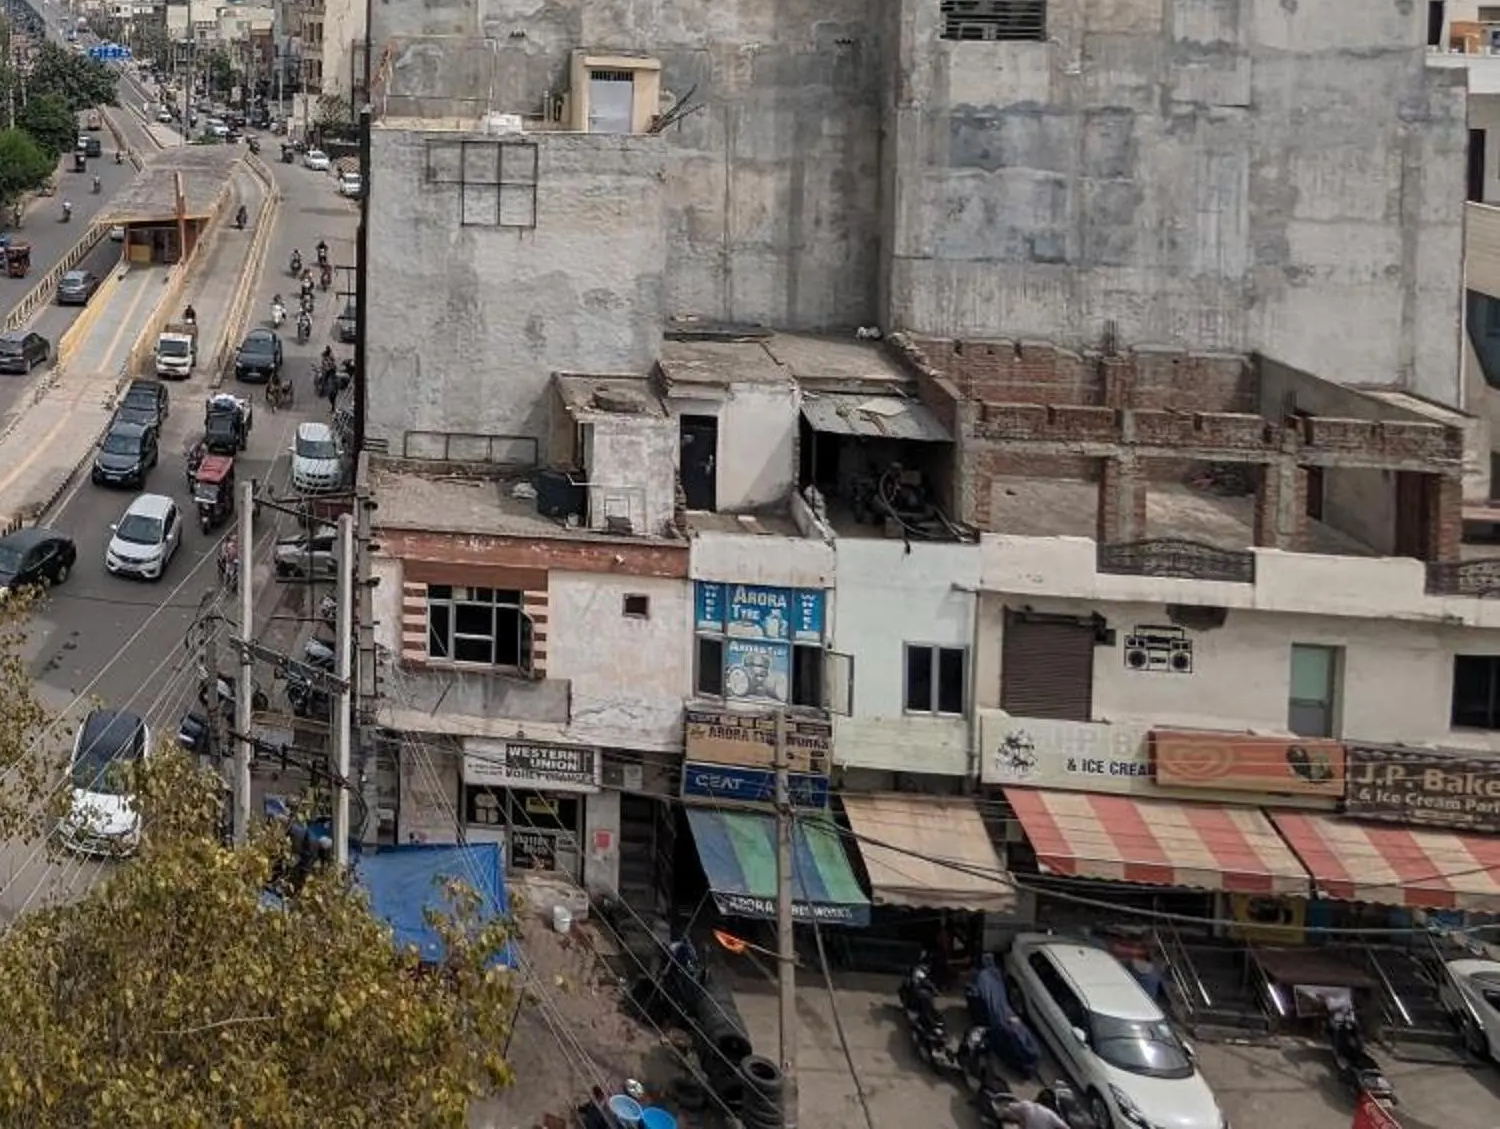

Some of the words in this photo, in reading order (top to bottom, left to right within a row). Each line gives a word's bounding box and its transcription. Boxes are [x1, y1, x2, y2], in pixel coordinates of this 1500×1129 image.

[508, 746, 579, 760] WESTERN
[529, 758, 578, 771] UNION
[1081, 759, 1105, 774] ICE
[1109, 761, 1150, 776] CREA
[695, 774, 745, 790] CEAT
[1376, 790, 1401, 804] Ice
[1404, 792, 1461, 810] Cream
